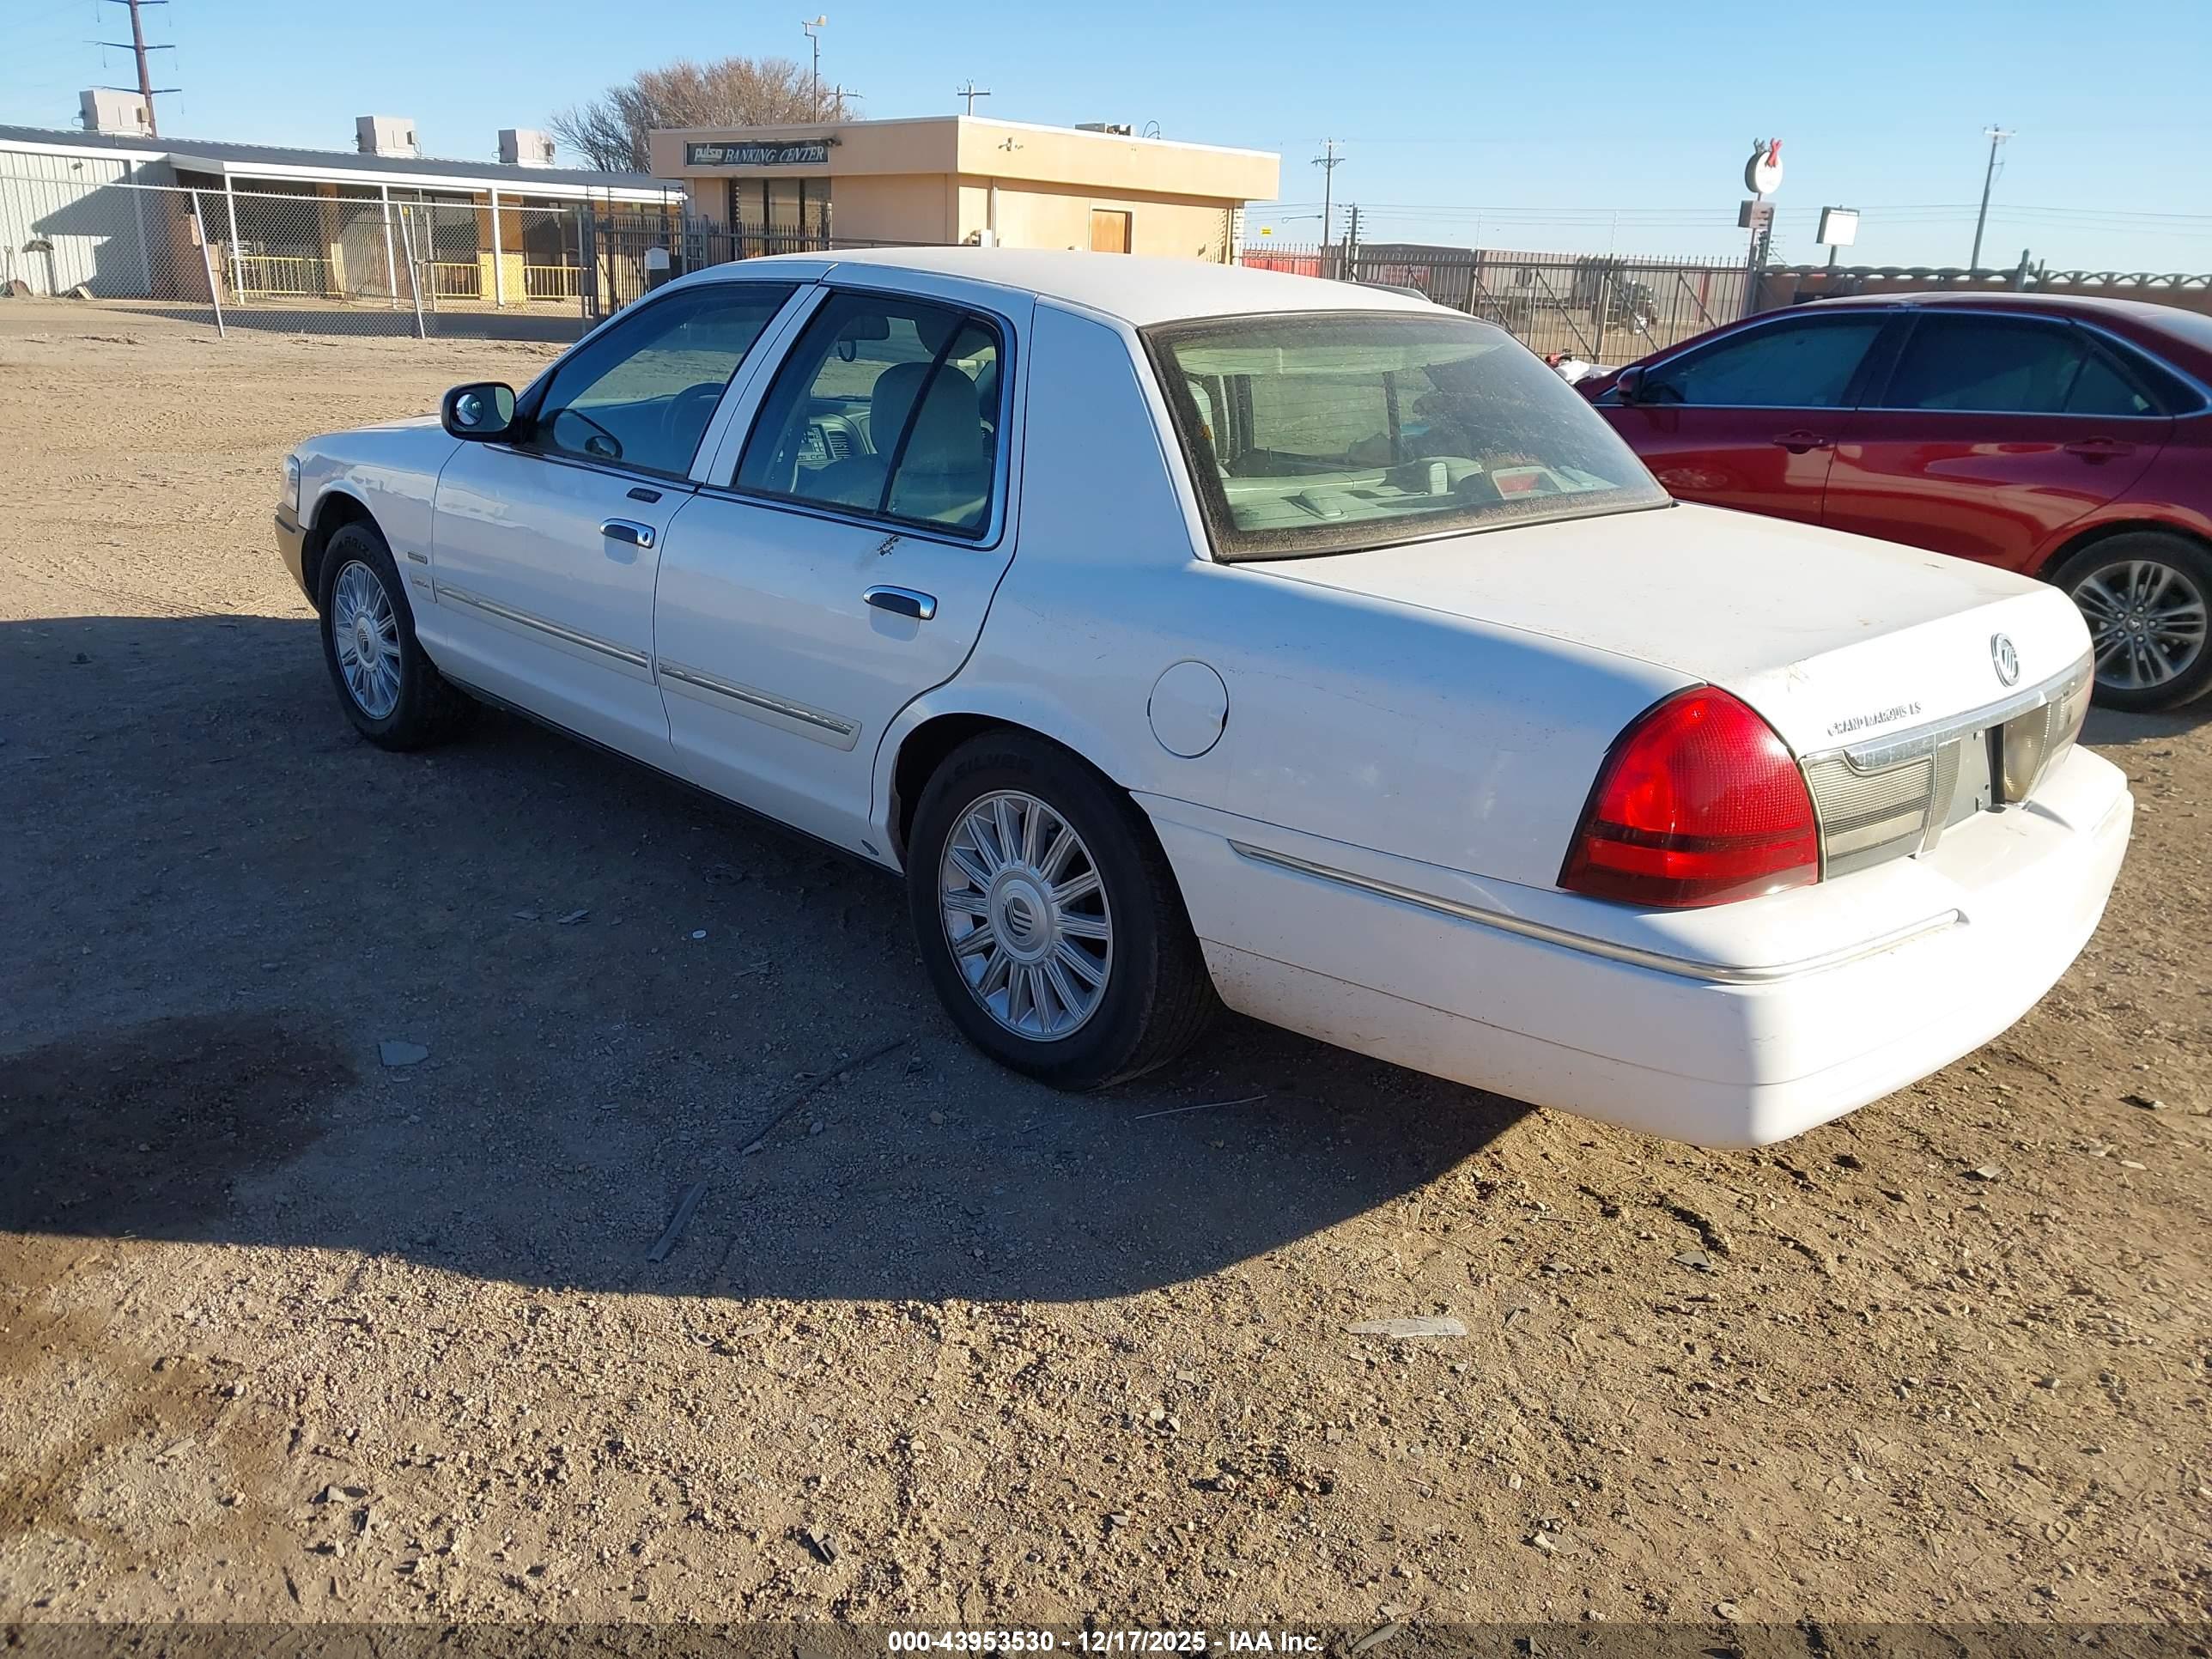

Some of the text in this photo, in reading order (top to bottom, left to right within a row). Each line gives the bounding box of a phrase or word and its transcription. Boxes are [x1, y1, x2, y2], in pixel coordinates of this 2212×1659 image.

[725, 148, 776, 162] BANKING
[779, 145, 824, 161] CENTER
[1827, 702, 1921, 736] GRAND MARQUIS LS
